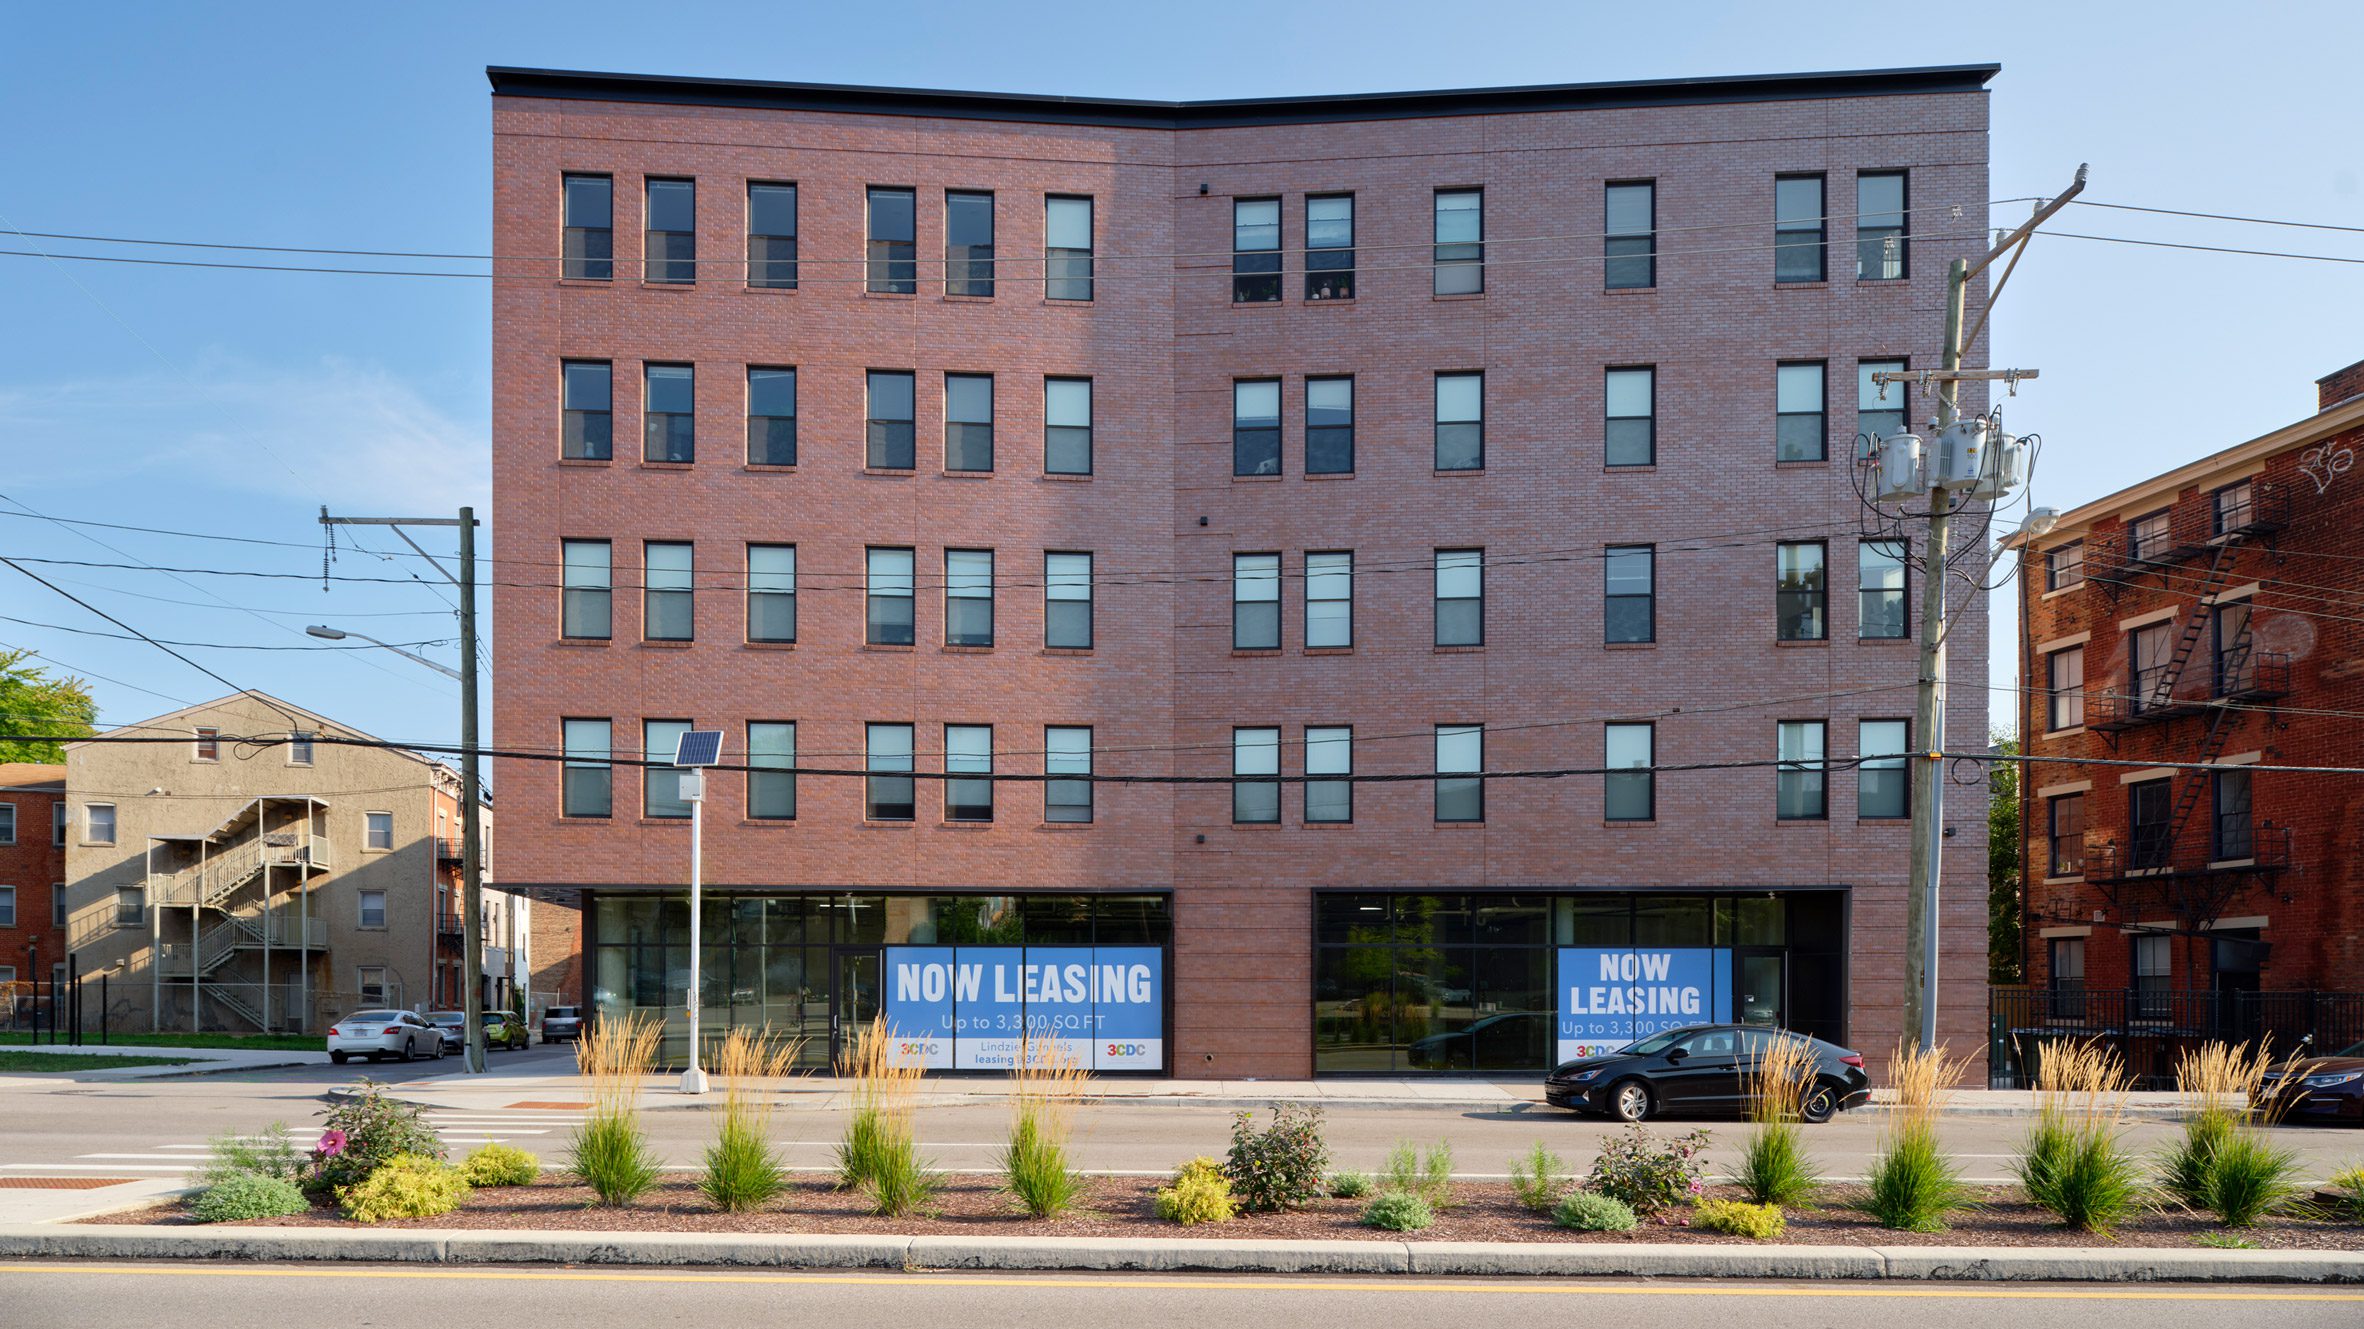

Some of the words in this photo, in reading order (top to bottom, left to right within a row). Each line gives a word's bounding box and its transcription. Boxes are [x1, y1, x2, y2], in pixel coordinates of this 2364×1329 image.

[1600, 953, 1671, 981] NOW
[897, 963, 982, 1002] NOW
[994, 964, 1151, 1004] LEASING
[1571, 986, 1700, 1015] LEASING
[941, 1014, 967, 1033] Up
[972, 1016, 990, 1029] to
[996, 1014, 1048, 1032] 3,300
[1562, 1021, 1584, 1037] Up
[1589, 1023, 1605, 1034] to
[1610, 1021, 1655, 1036] 3,300
[901, 1043, 939, 1056] 3CDC
[1107, 1043, 1146, 1057] 3CDC
